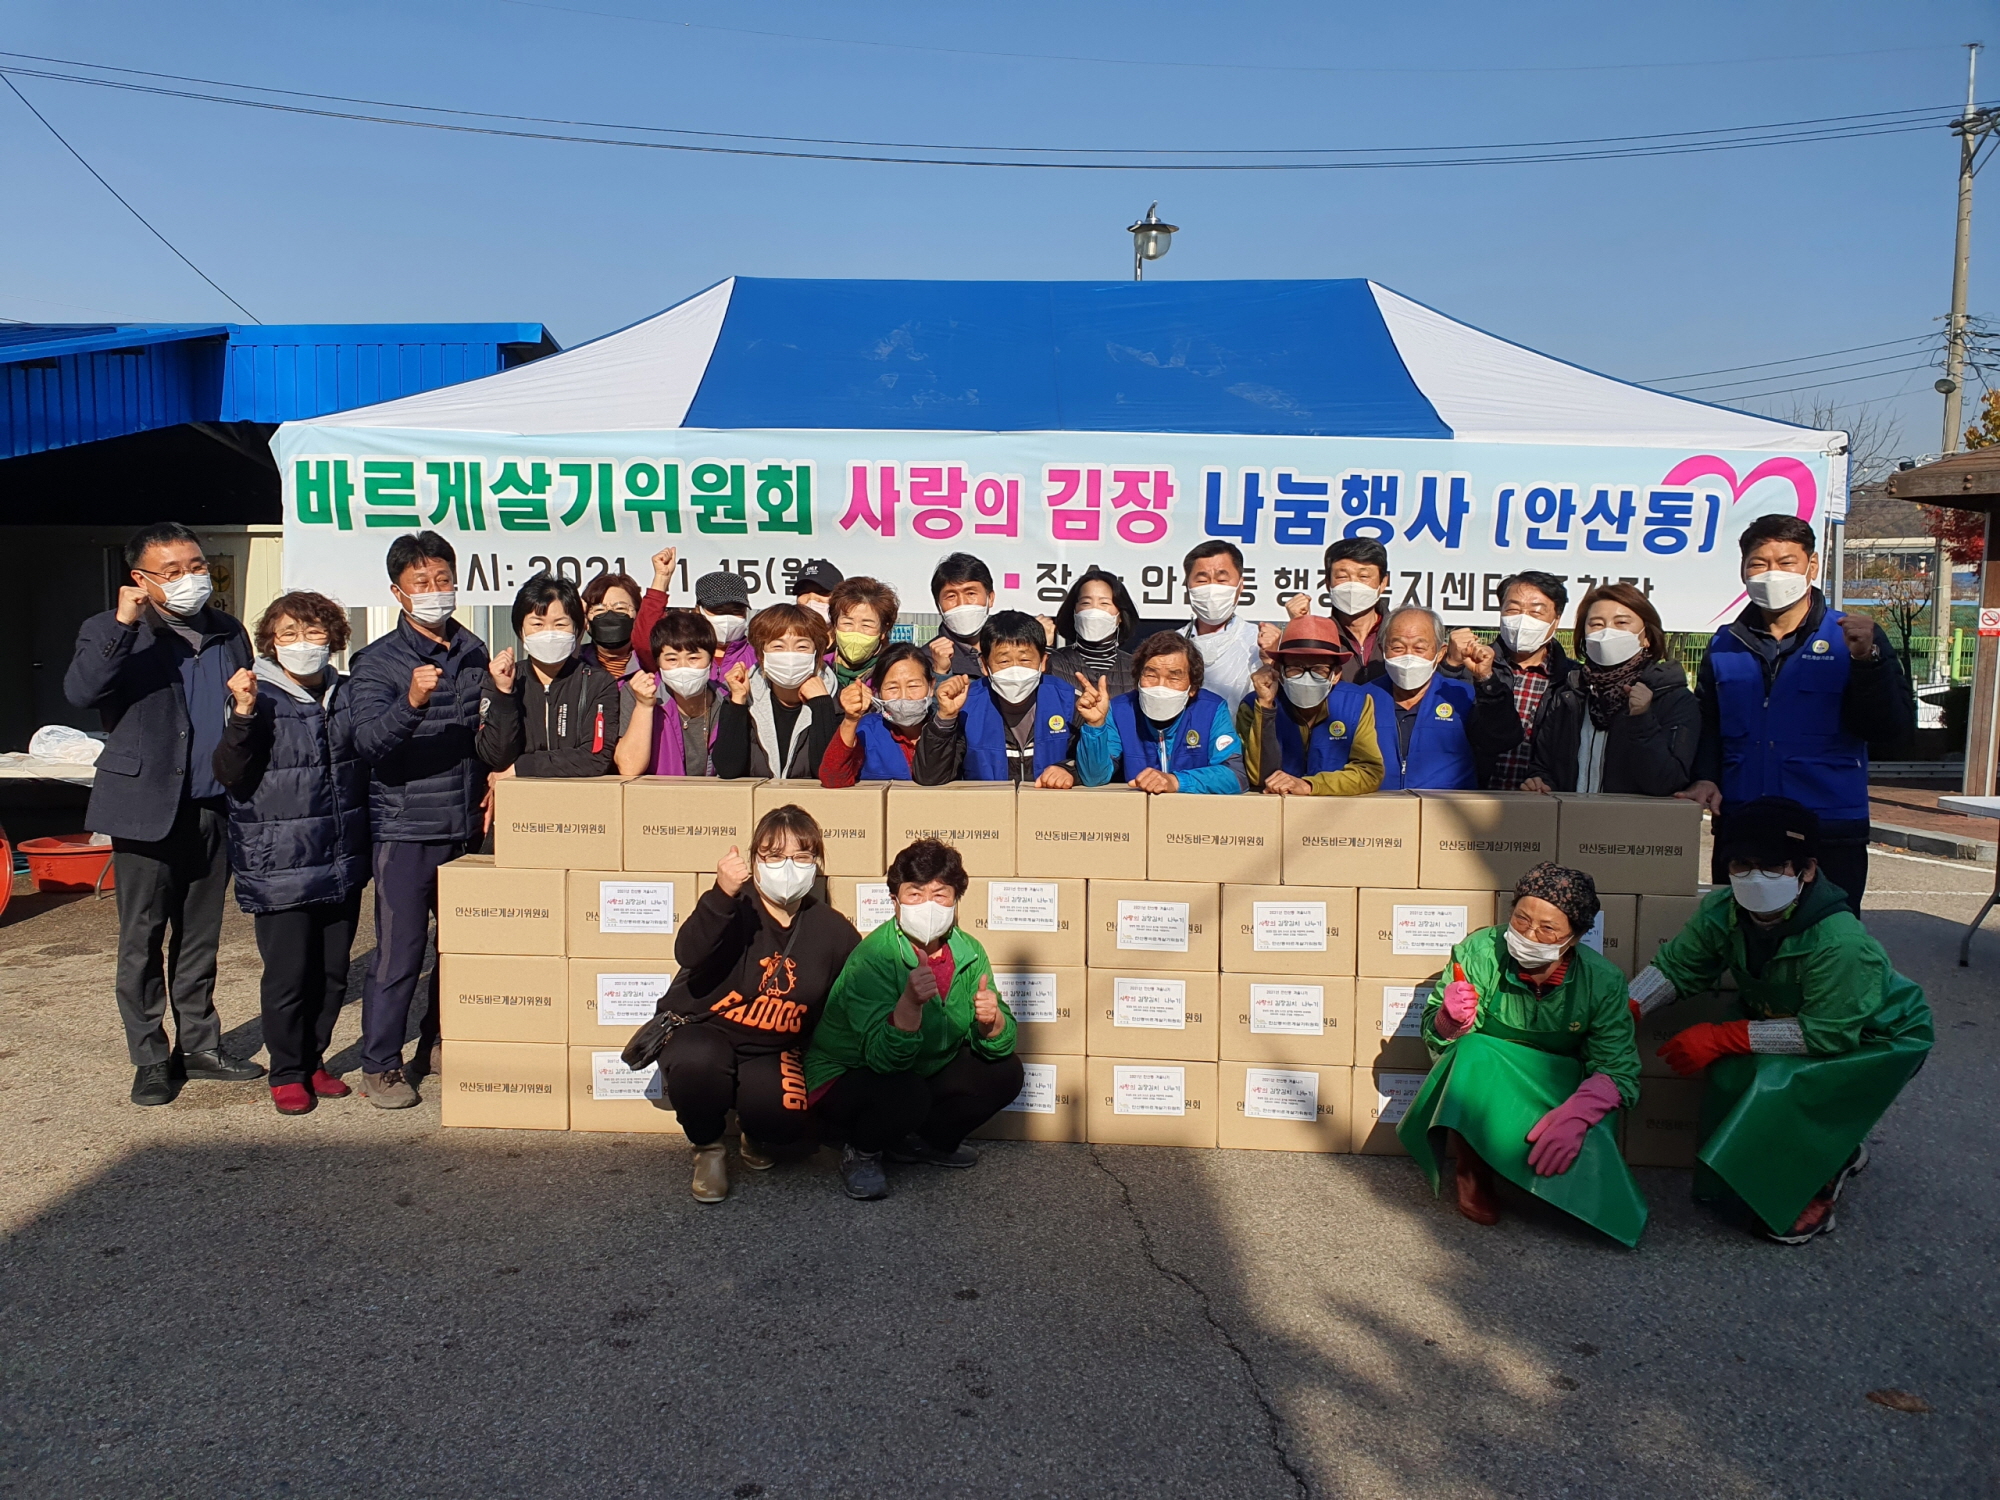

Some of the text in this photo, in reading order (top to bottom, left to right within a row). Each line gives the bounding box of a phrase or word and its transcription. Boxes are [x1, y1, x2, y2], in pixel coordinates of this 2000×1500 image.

[296, 459, 813, 536] 바르게살기위원회
[838, 465, 1020, 540] 사랑의
[1046, 468, 1175, 545] 김장
[1203, 471, 1471, 550] 나눔행사
[511, 821, 606, 835] 안산동바르게살기위원회
[642, 823, 737, 837] 안산동바르게살기위원회
[1034, 830, 1130, 843] 안산동바르게살기위원회
[1166, 833, 1264, 847] 안산동바르게살기위원회
[1301, 835, 1403, 849] 안산동바르게살기위원회
[1439, 840, 1541, 853] 안산동바르게살기위원회
[1579, 843, 1683, 857] 안산동바르게살기위원회
[455, 906, 549, 919] 안산동바르게살기위원회
[458, 993, 552, 1007] 안산동바르게살기위원회
[459, 1081, 552, 1095] 안산동바르게살기위원회
